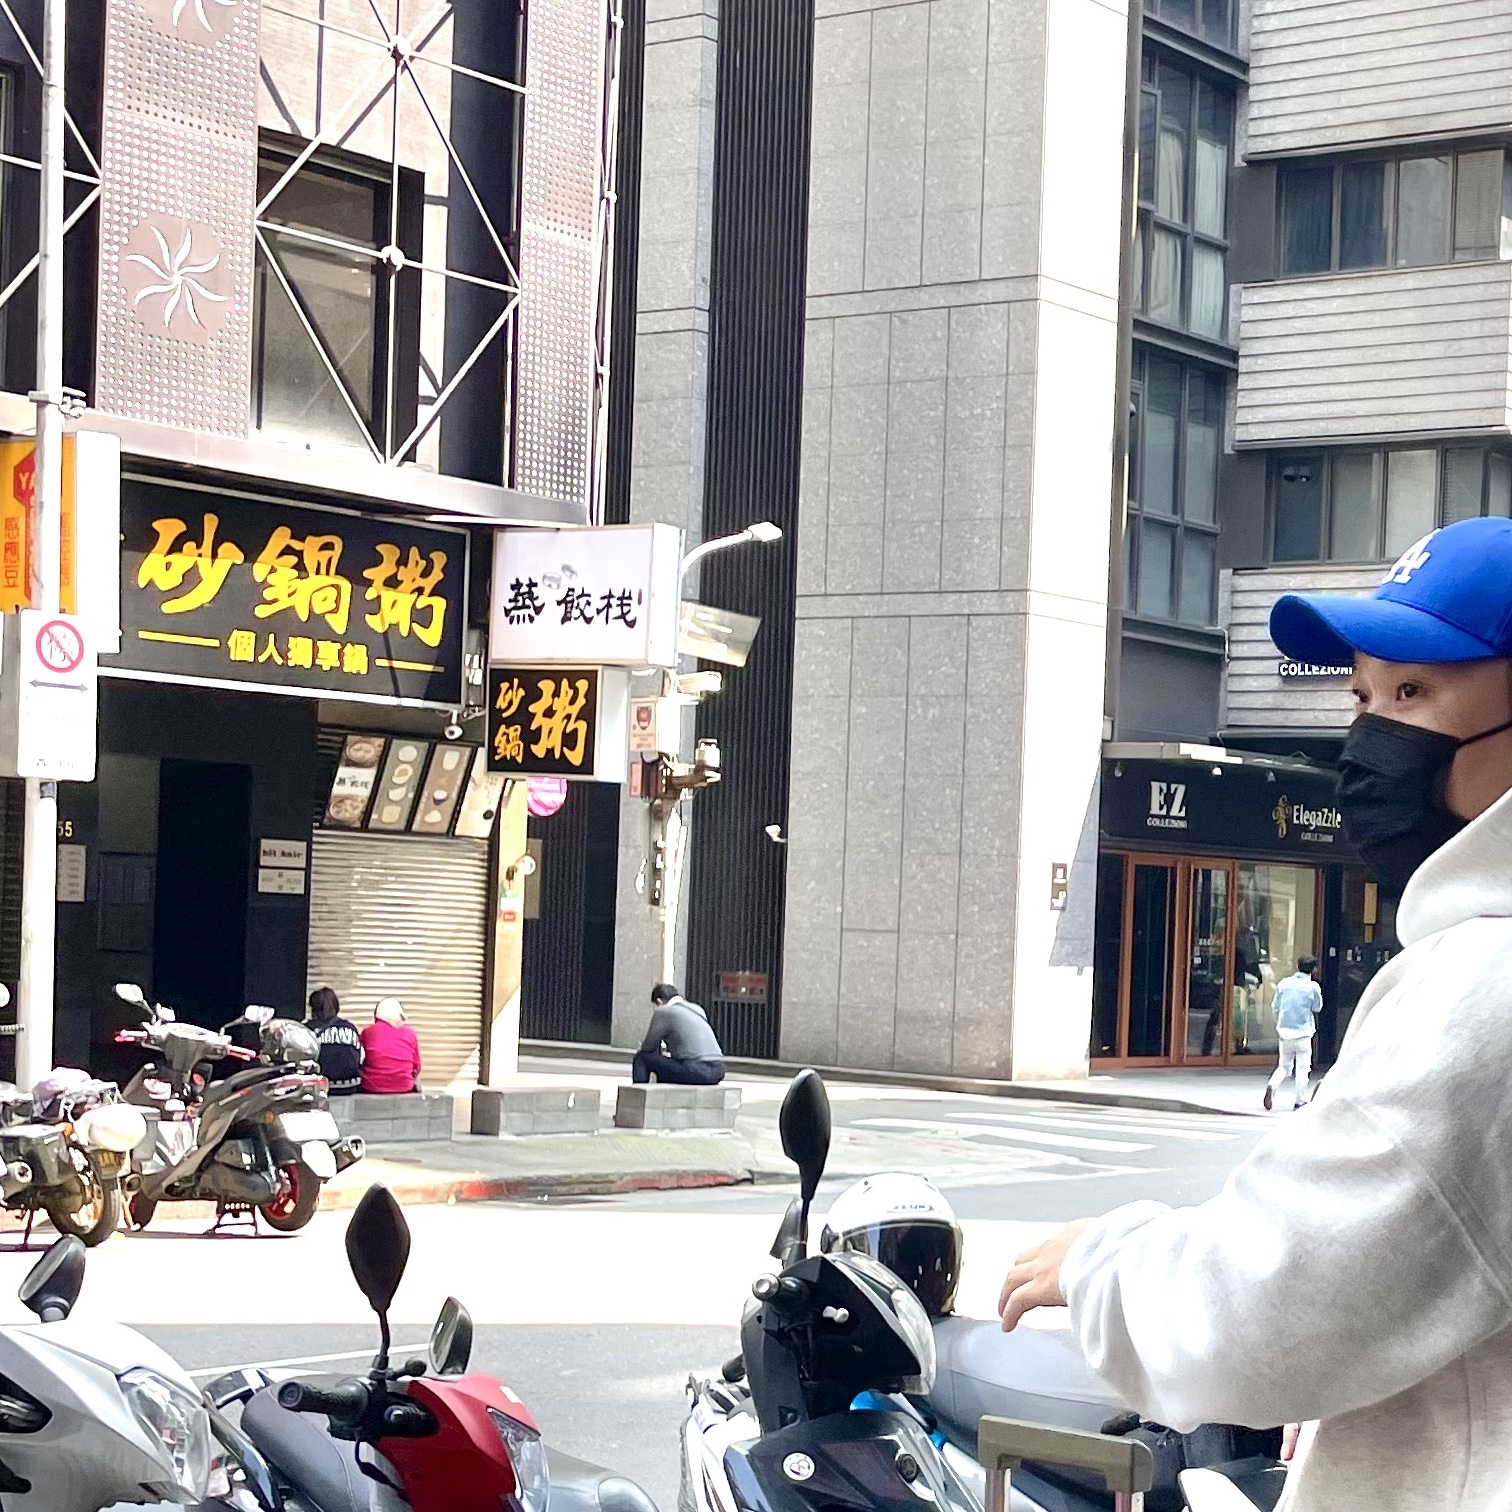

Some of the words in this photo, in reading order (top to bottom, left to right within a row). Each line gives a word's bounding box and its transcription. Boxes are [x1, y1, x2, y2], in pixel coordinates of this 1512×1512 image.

[137, 513, 448, 648] 砂鍋粥
[494, 677, 526, 764] 砂鍋
[528, 677, 590, 767] 粥
[1150, 780, 1188, 818] EZ
